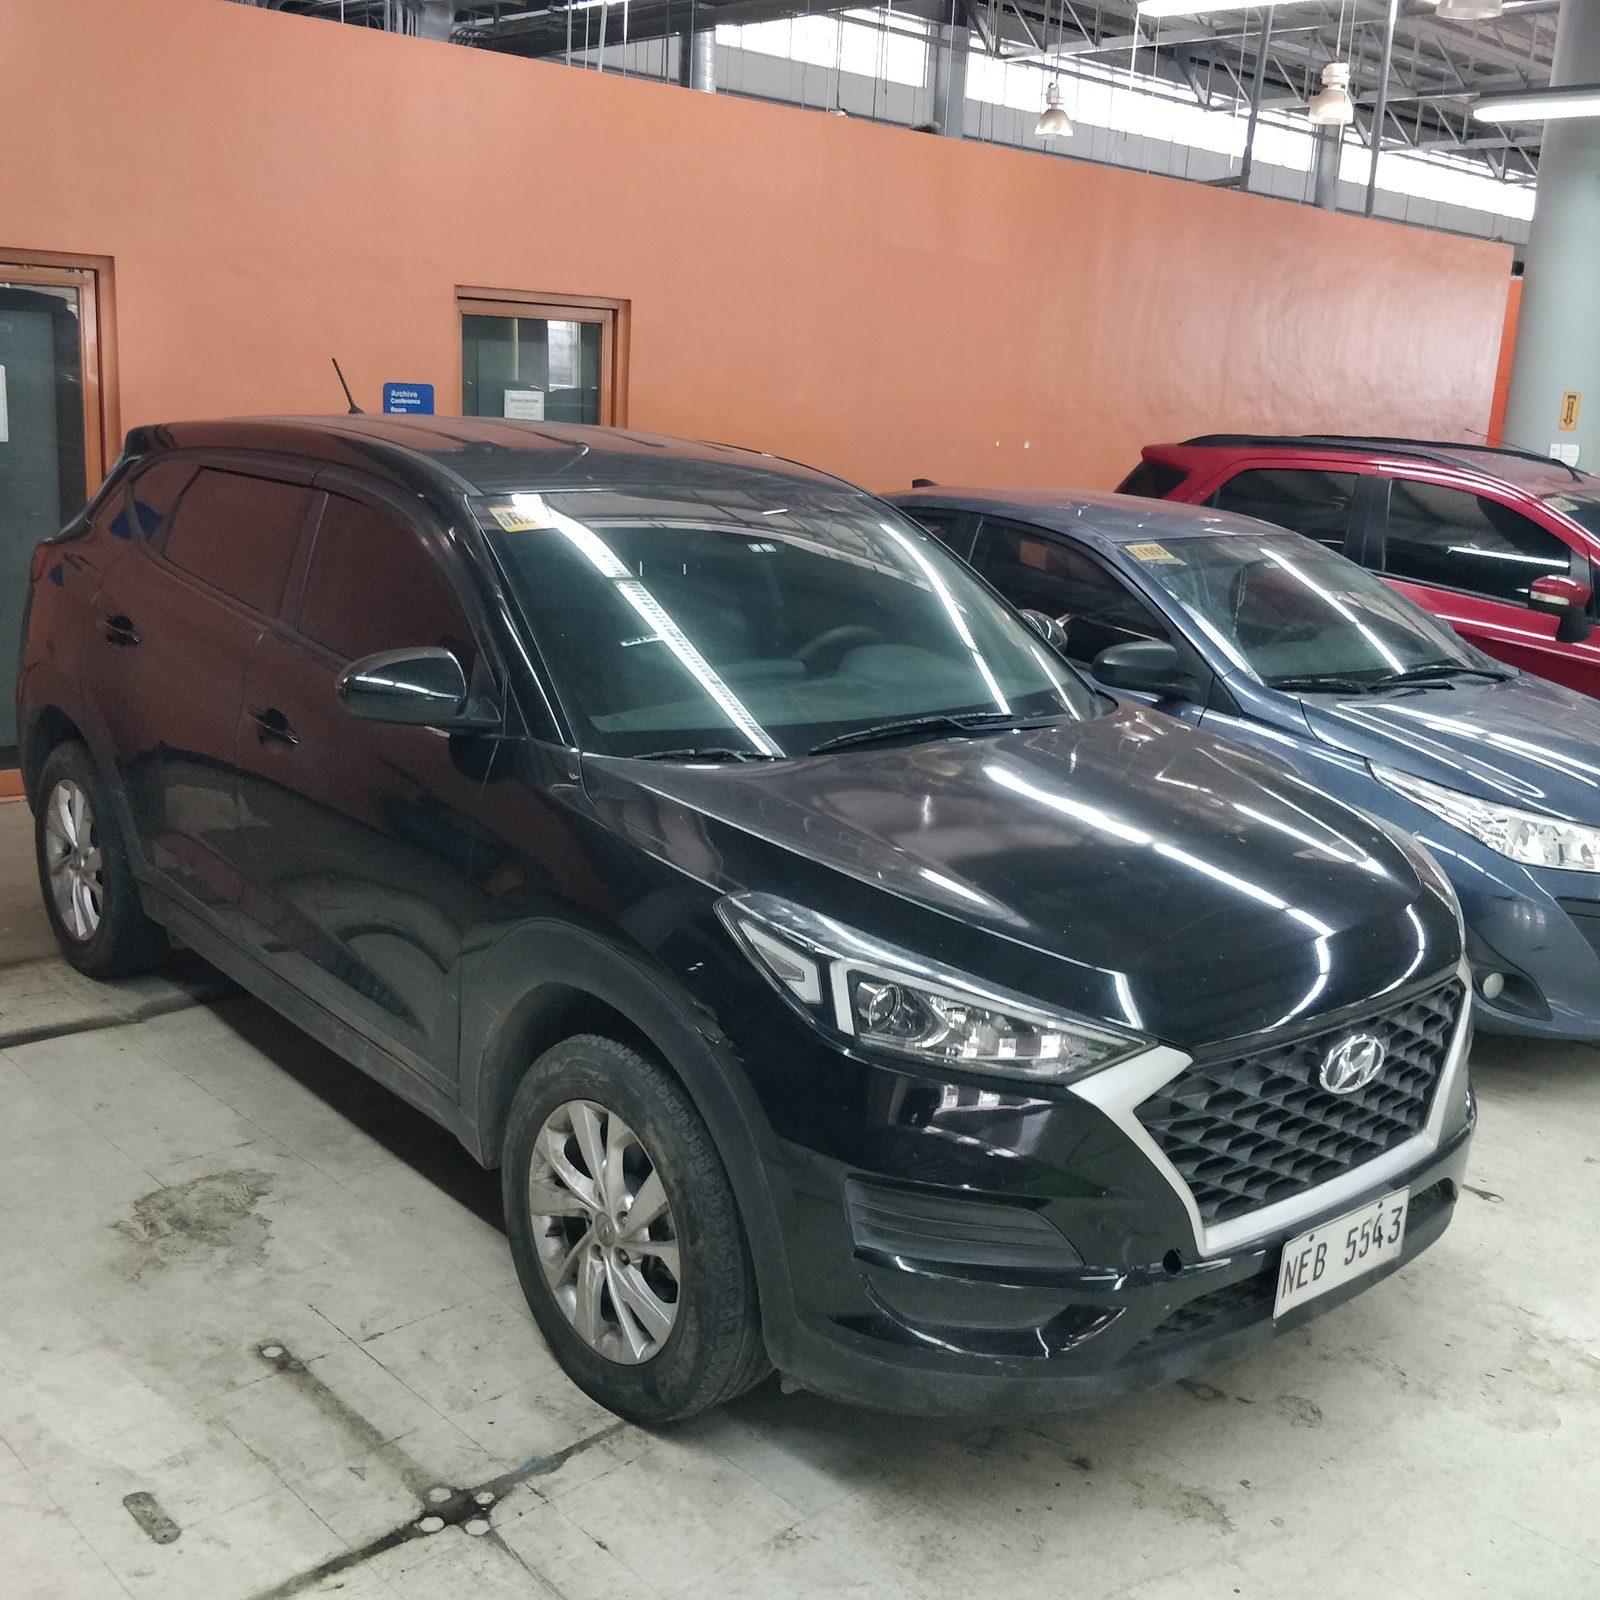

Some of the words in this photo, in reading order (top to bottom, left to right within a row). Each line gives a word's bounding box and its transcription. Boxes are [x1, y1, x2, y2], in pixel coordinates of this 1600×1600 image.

[391, 390, 418, 398] Archive
[1281, 1242, 1328, 1298] NEB
[1344, 1205, 1404, 1266] 5543
